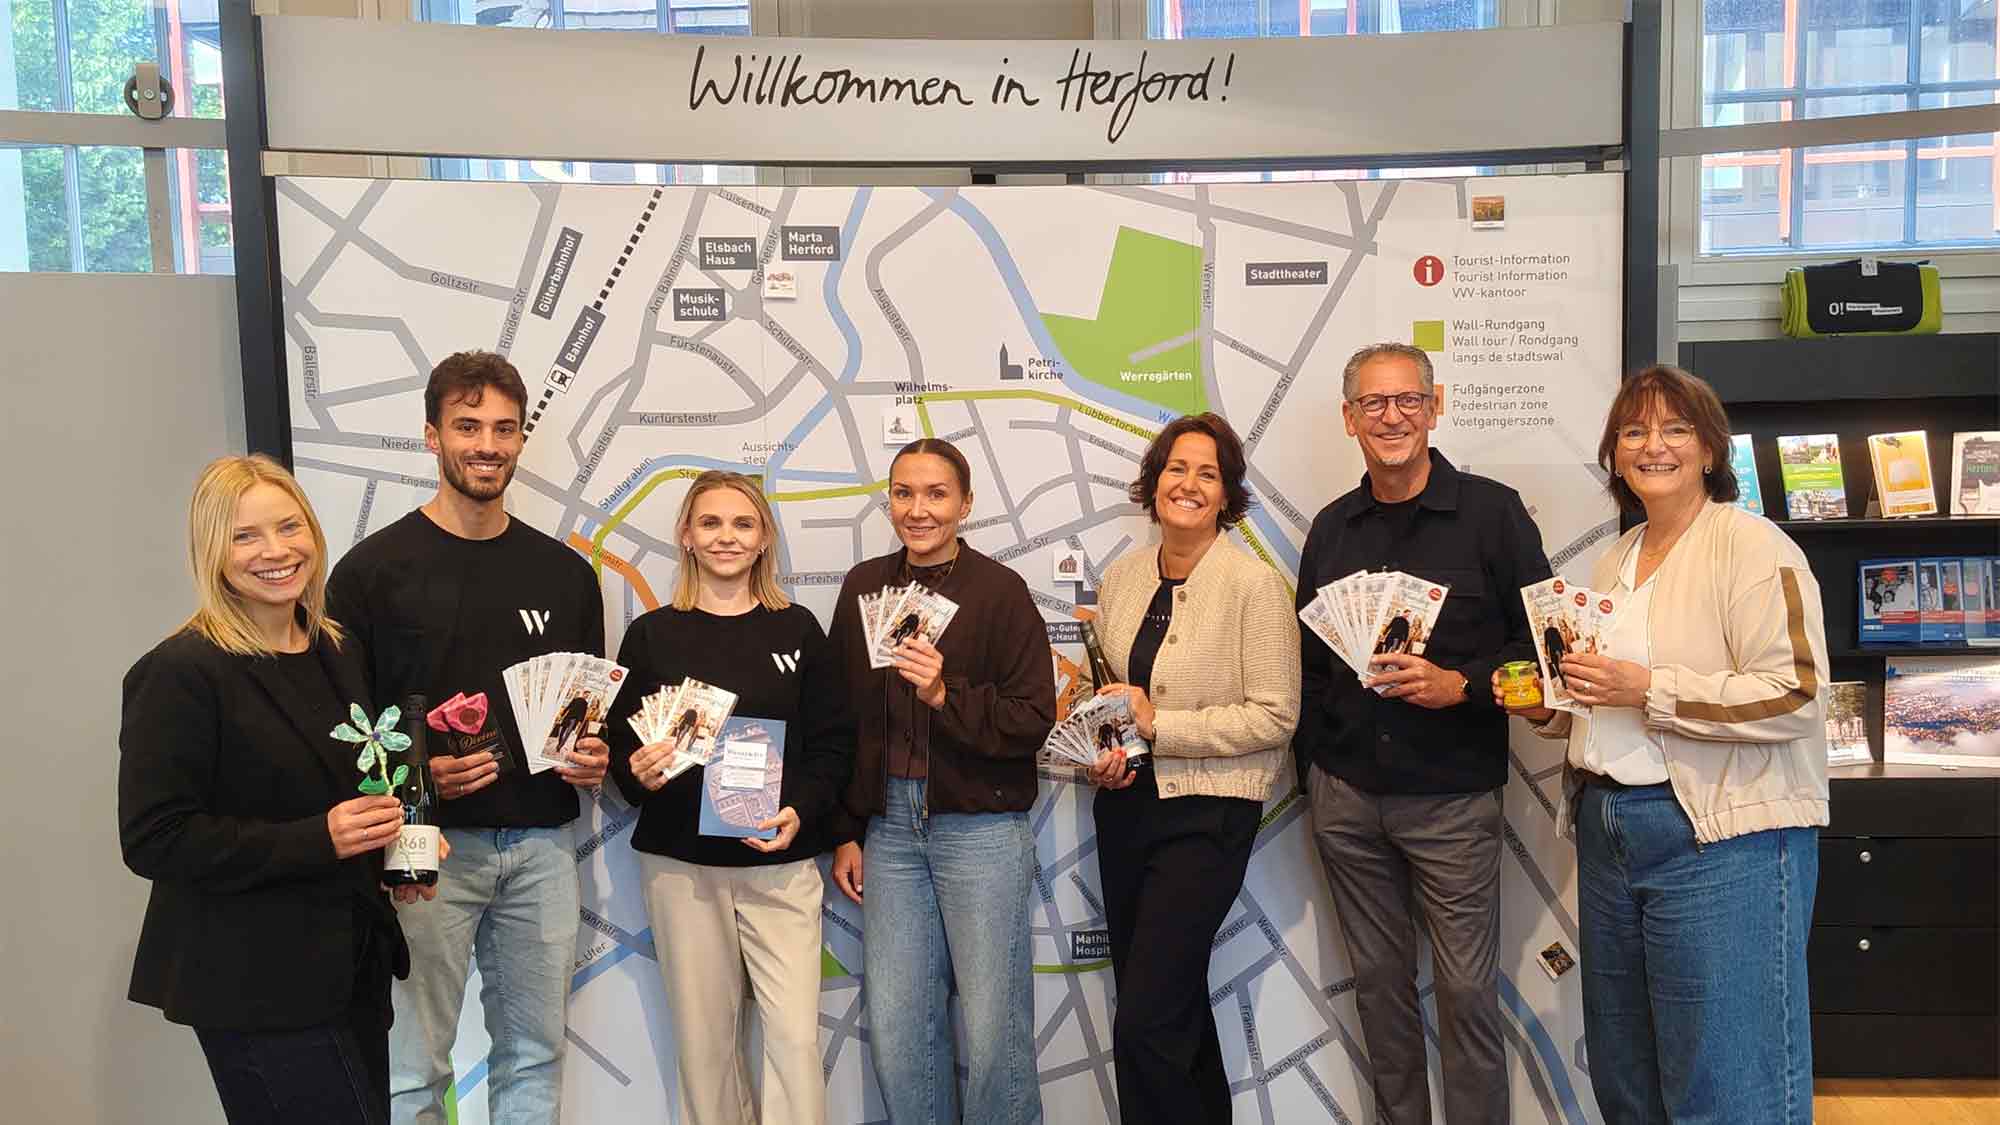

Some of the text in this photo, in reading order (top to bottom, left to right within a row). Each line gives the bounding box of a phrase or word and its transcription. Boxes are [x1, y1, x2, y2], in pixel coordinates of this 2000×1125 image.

[689, 46, 1234, 143] Willkommen in Herford!
[788, 232, 823, 242] Marta
[705, 242, 751, 253] Elsbach
[788, 244, 834, 255] Herford
[658, 232, 696, 293] Bahndamm
[705, 255, 736, 265] Haus
[1453, 255, 1570, 266] Tourist-Information
[538, 234, 577, 312] Güterbahnhof
[1250, 269, 1322, 280] Stadttheater
[1453, 270, 1568, 282] Tourist Information
[1453, 287, 1527, 298] VVV-kantoor
[679, 294, 719, 304] Musik-
[679, 306, 719, 317] schule
[1829, 302, 1845, 315] O!
[500, 310, 521, 349] Bünder
[1453, 320, 1545, 332] Wall-Rundgang
[564, 316, 597, 363] Bahnhof
[1453, 336, 1478, 347] Wall
[1482, 336, 1507, 347] tour
[1518, 334, 1579, 347] Rondgang
[1028, 358, 1060, 368] Petri-
[1453, 351, 1564, 365] langs de stadtswal
[1028, 370, 1063, 380] kirche
[1120, 371, 1192, 382] Werregärten
[895, 382, 952, 392] Wilhelms-
[1453, 383, 1545, 396] Fußgängerzone
[895, 395, 925, 406] platz
[1453, 400, 1549, 411] Pedestrian zone
[1248, 391, 1282, 444] Mindener
[1453, 416, 1555, 428] Voetgangerszone
[382, 437, 425, 450] Nieder
[742, 441, 798, 452] Aussichts-
[743, 455, 767, 466] steg
[600, 456, 653, 510] Stadtgraben
[804, 574, 844, 585] Freihei
[1076, 935, 1110, 945] Mathil
[1076, 946, 1111, 957] Hospit
